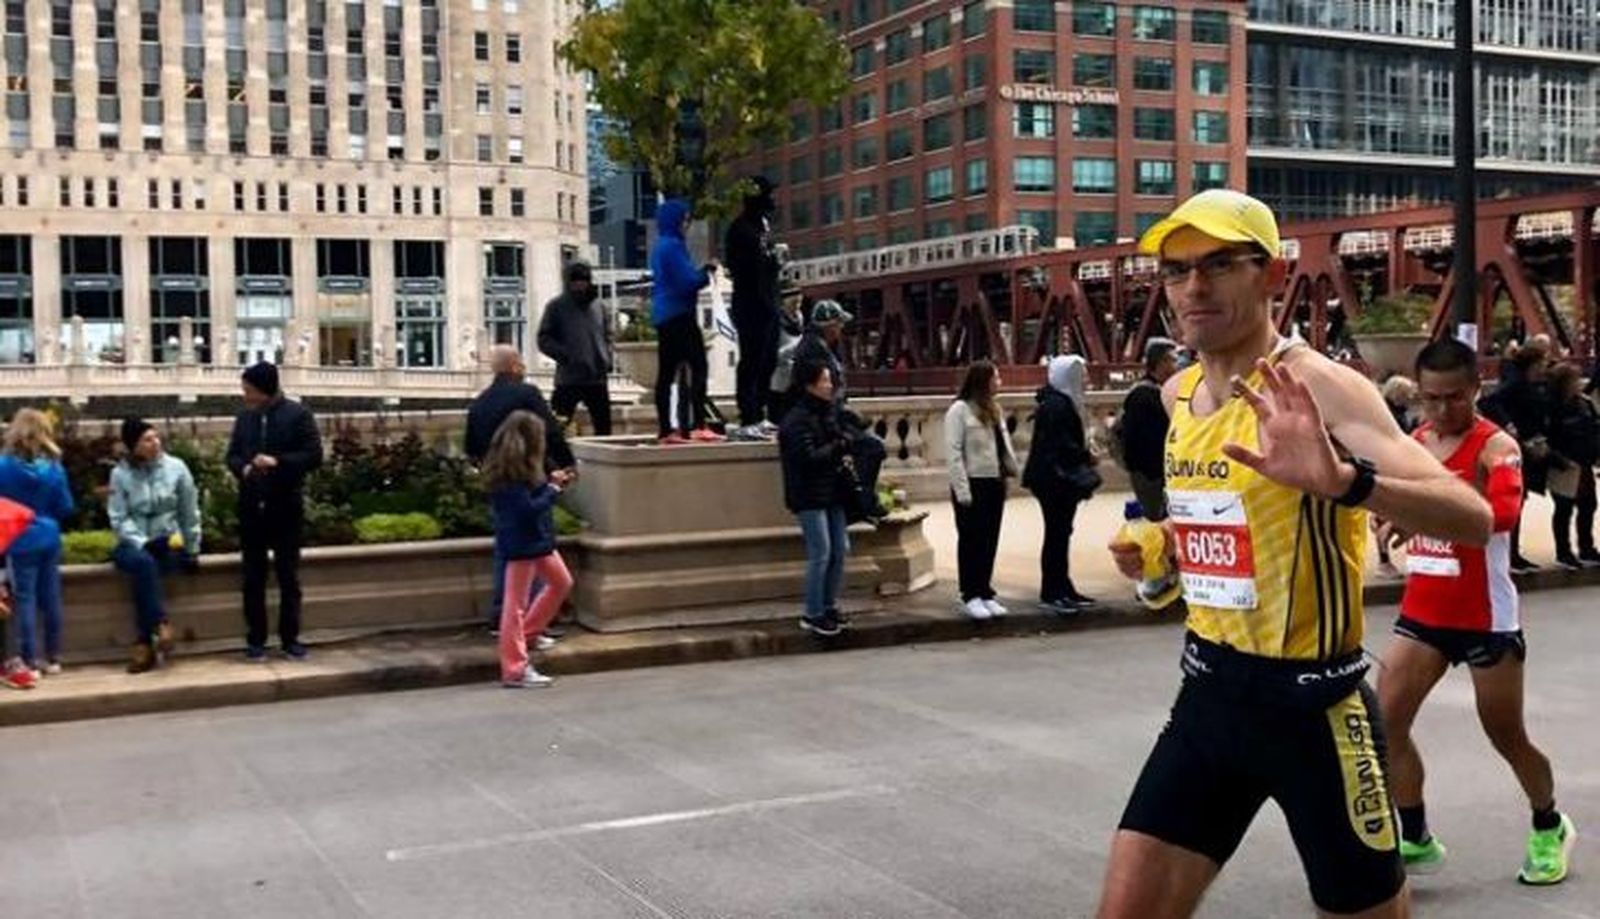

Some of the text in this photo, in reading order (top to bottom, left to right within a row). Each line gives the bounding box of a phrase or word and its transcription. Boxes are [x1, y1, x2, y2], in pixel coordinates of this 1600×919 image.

[1014, 85, 1119, 104] The Chicago School
[1208, 460, 1230, 479] GO
[1187, 531, 1237, 567] 6053
